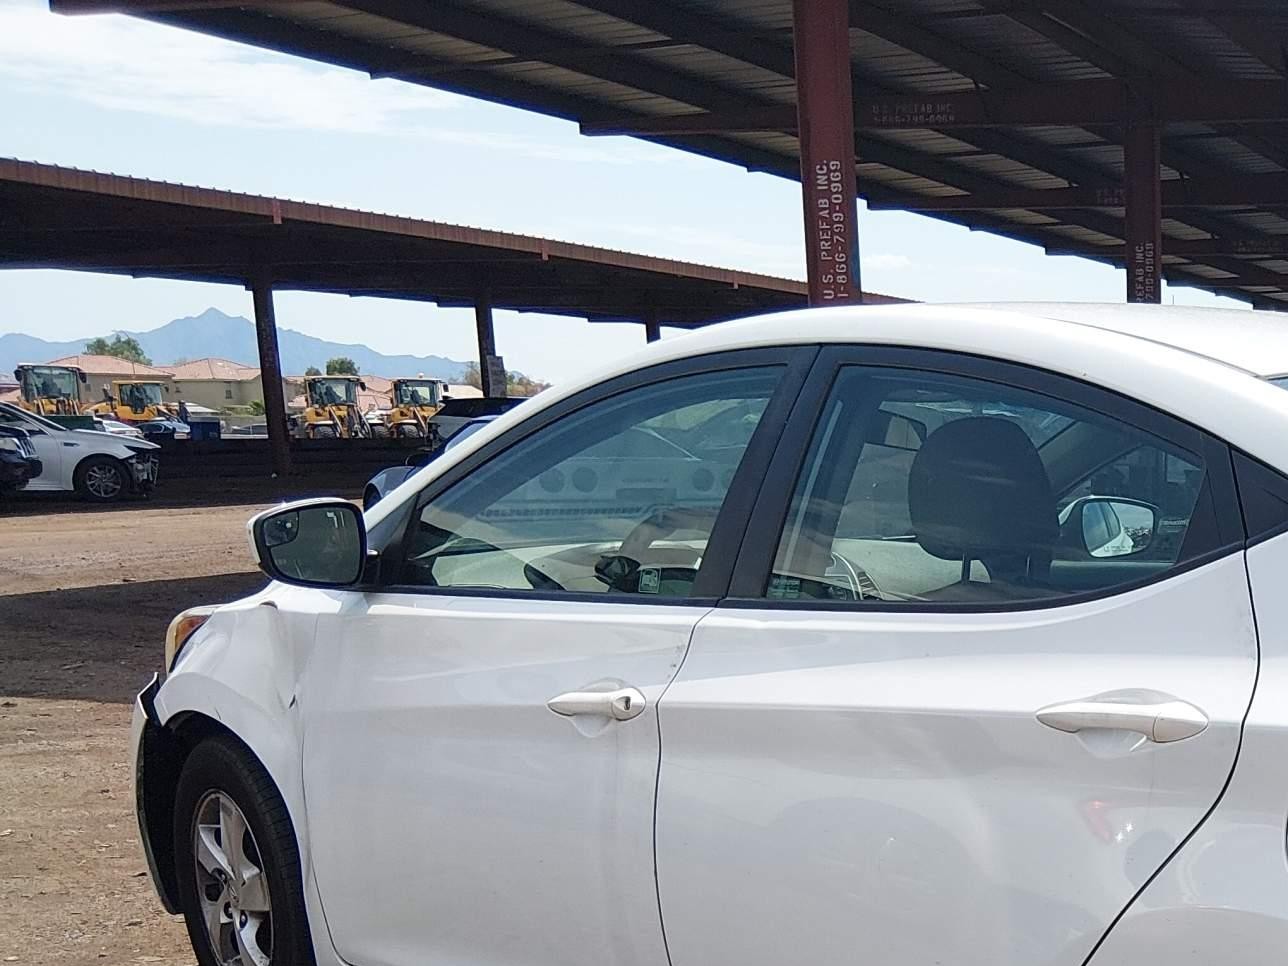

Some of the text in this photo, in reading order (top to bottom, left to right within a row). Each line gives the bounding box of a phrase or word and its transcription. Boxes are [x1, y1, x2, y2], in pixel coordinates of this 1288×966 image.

[815, 159, 835, 300] U.S. PREFAB INC.
[829, 160, 849, 297] 1-866-799-0969
